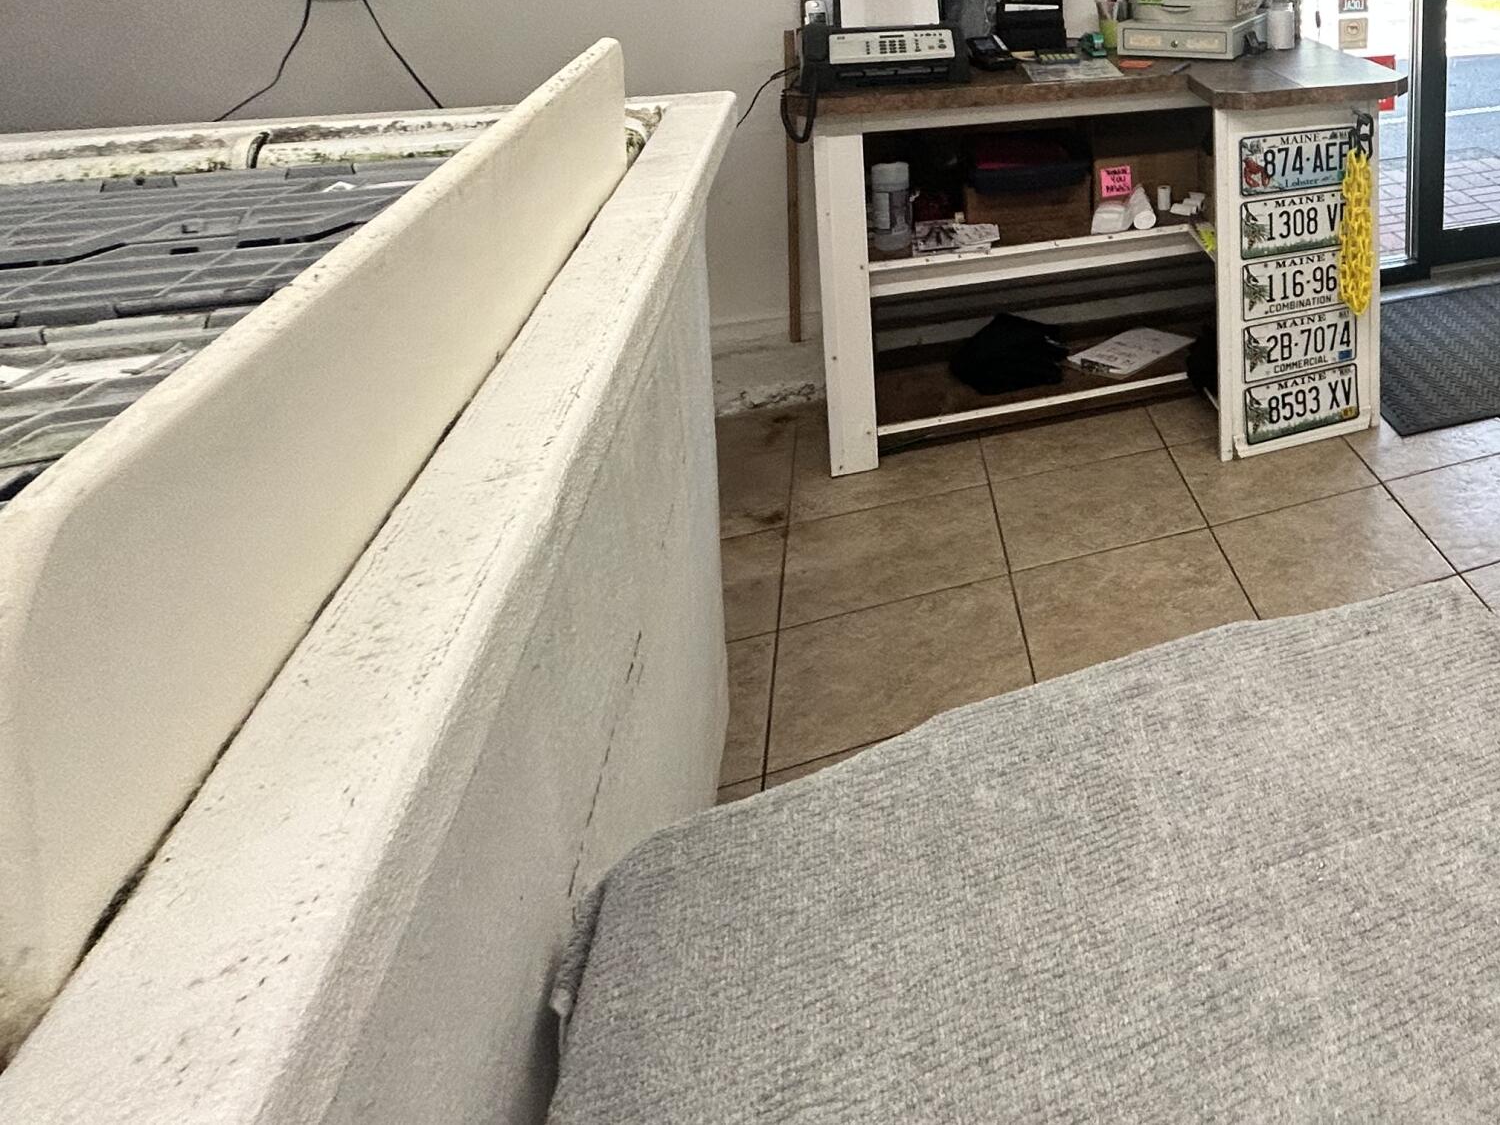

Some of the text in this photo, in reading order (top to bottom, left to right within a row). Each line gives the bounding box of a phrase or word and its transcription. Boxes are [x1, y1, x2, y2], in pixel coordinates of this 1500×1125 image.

[1280, 133, 1321, 145] MAINE
[1284, 178, 1320, 188] Lobster
[1274, 195, 1325, 208] MAINE
[1267, 207, 1318, 241] 1308
[1276, 254, 1326, 269] MAINE
[1269, 295, 1332, 314] COMBINATION
[1277, 314, 1327, 330] MAINE
[1274, 355, 1328, 373] COMMERCIAL
[1277, 372, 1327, 390] MAINE
[1268, 377, 1352, 424] 8593 XV
